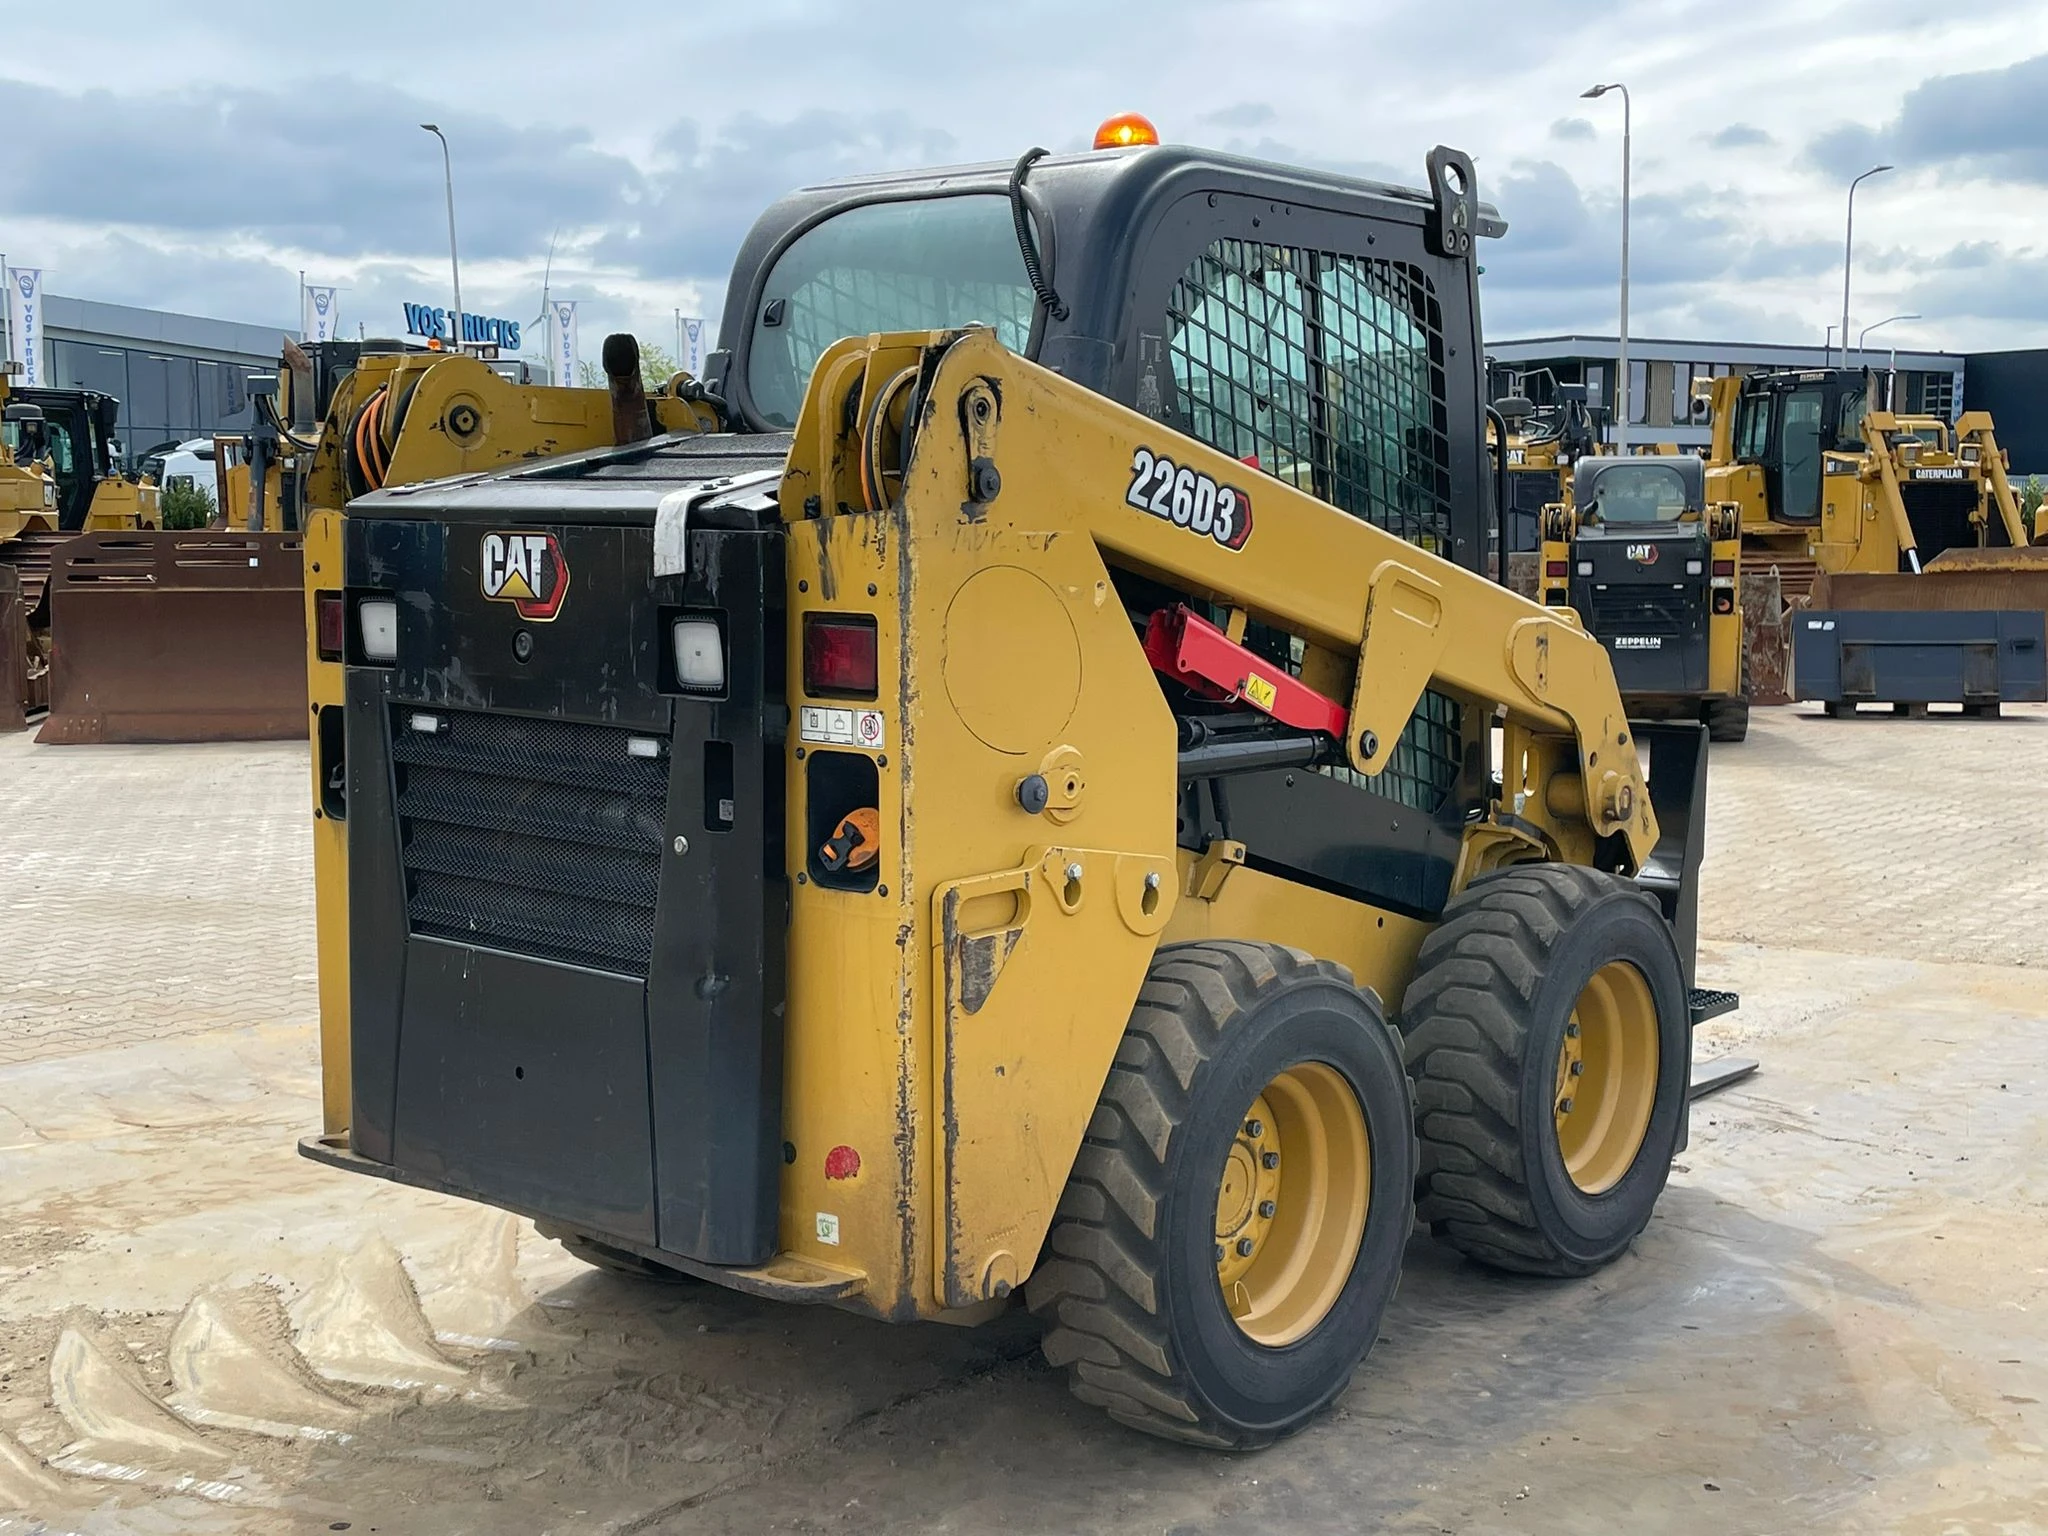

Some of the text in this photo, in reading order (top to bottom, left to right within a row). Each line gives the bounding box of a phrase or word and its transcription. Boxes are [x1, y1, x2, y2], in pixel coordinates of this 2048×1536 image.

[318, 321, 326, 340] VO
[403, 302, 521, 350] VOS TRUCKS
[24, 304, 36, 387] VOS TRUCK
[563, 333, 571, 358] VOS
[1915, 468, 1963, 479] CATERPILLAR
[1127, 449, 1236, 542] 226D3
[1626, 543, 1651, 560] CAT
[482, 534, 548, 598] CAT
[1615, 637, 1661, 645] ZEPPELIN
